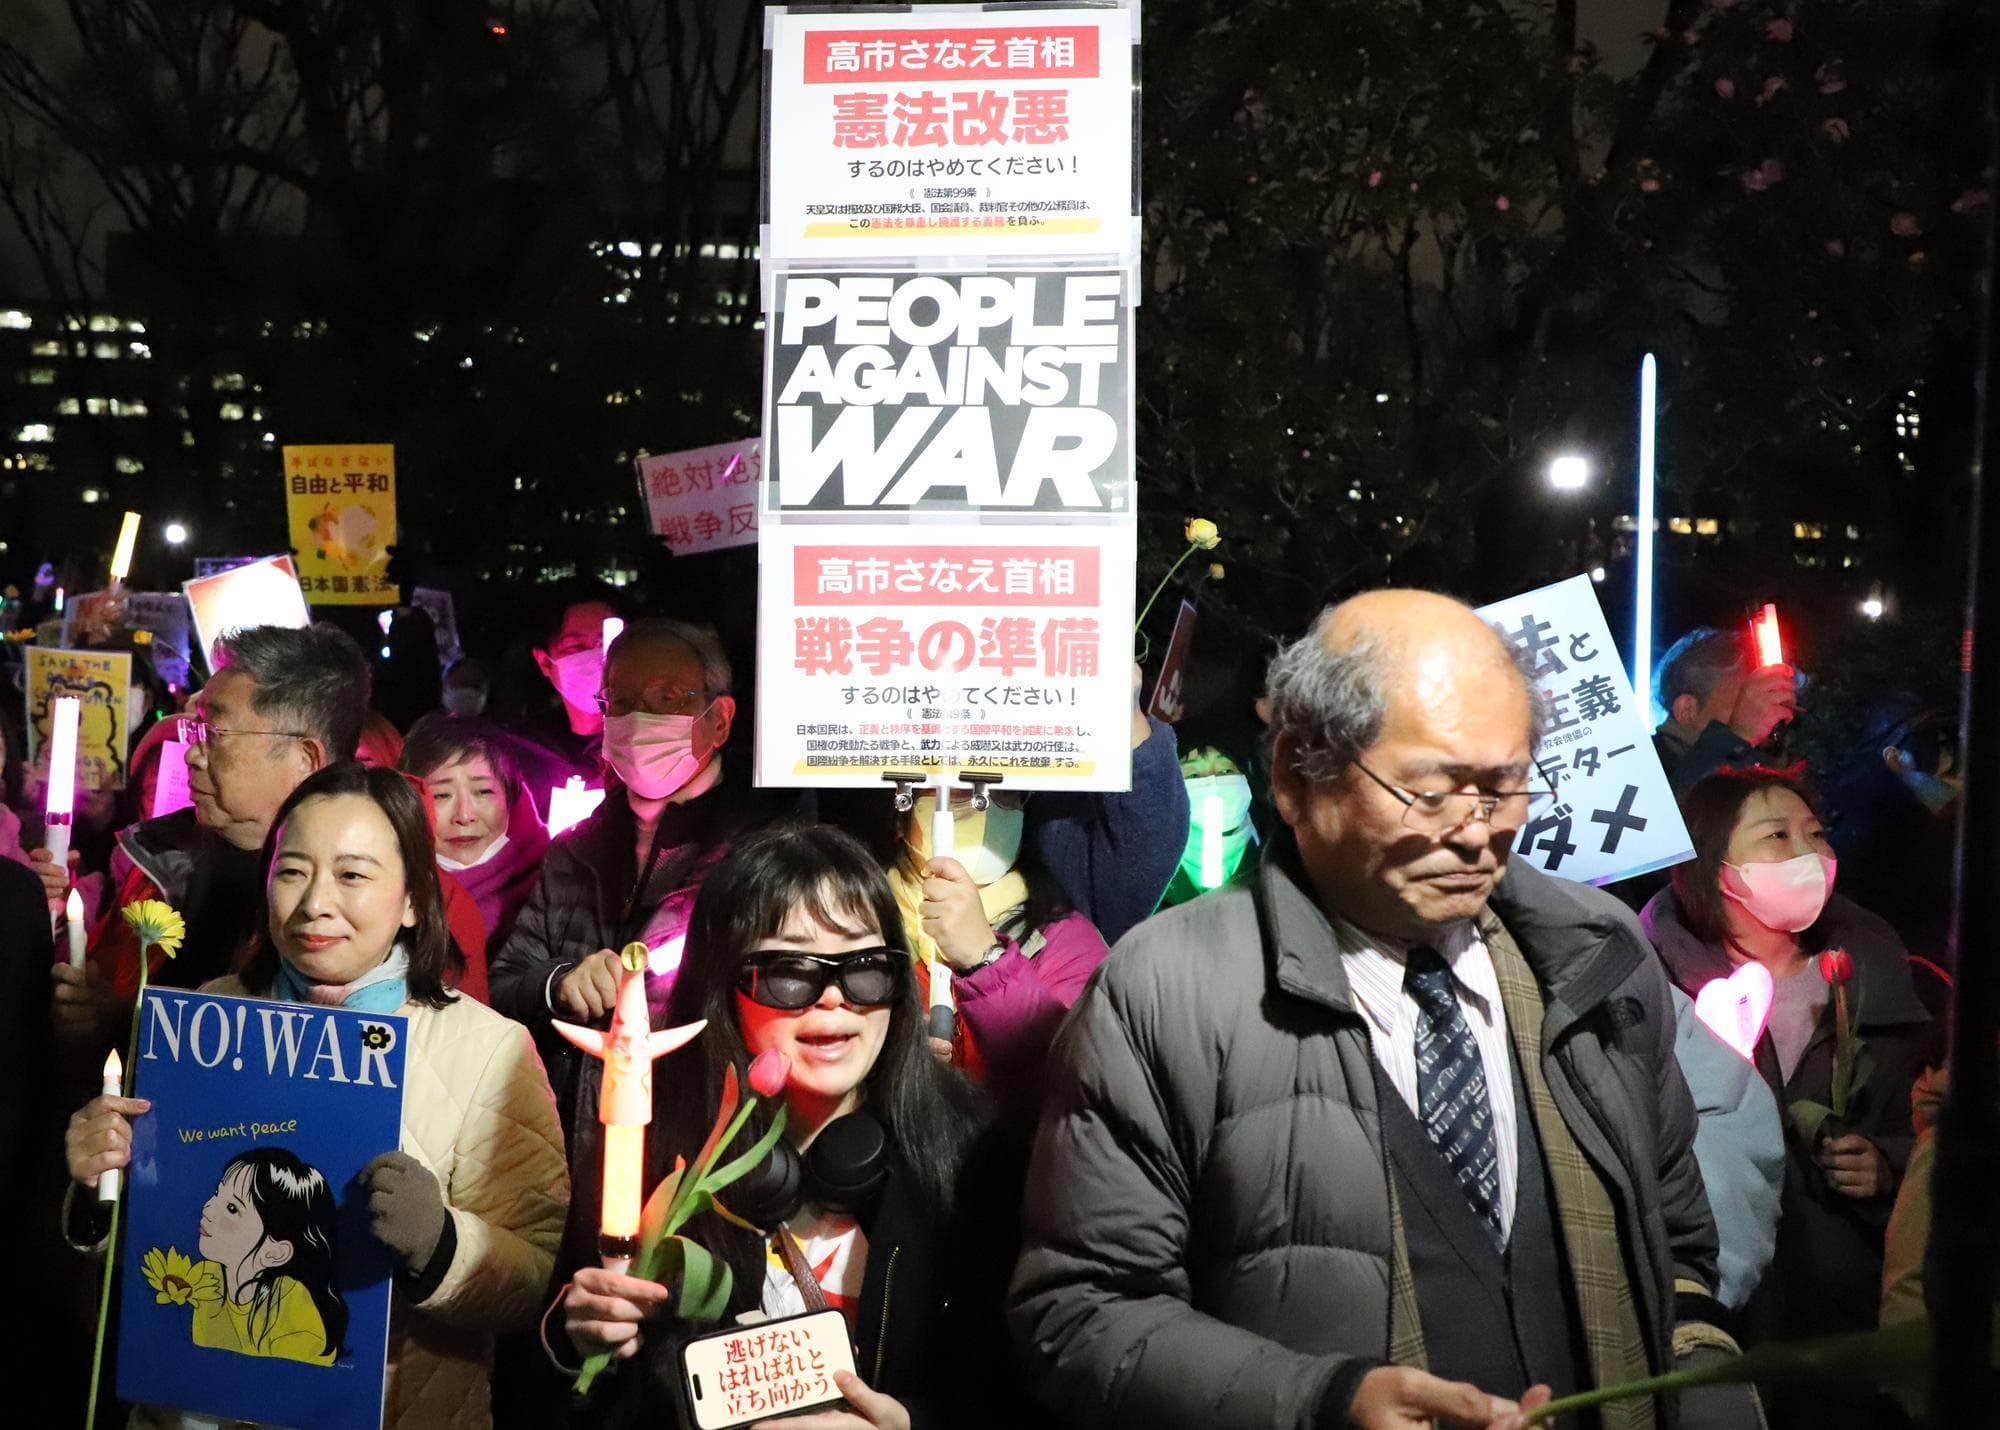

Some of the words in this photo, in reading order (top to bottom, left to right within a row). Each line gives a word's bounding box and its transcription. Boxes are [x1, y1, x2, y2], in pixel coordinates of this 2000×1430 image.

[826, 36, 1075, 73] 高市さなえ首相
[832, 89, 1069, 149] 憲法改悪
[848, 156, 1078, 179] するのはやめてください！
[781, 276, 1121, 346] PEOPLE
[777, 345, 1118, 406] AGAINST
[777, 405, 1118, 507] WAR
[291, 473, 389, 494] 自由と平和
[817, 557, 1075, 595] 高市さなえ首相
[793, 616, 1100, 677] 戦争の準備
[1528, 744, 1636, 789] デター
[1516, 784, 1648, 871] ダメ
[143, 996, 247, 1072] NO!
[257, 1009, 398, 1089] WAR
[178, 1128, 204, 1143] We
[207, 1122, 247, 1139] want
[250, 1119, 297, 1141] peace
[724, 1328, 811, 1365] 逃げない
[718, 1348, 825, 1392] はればれと
[727, 1372, 829, 1416] 立ち向かう
